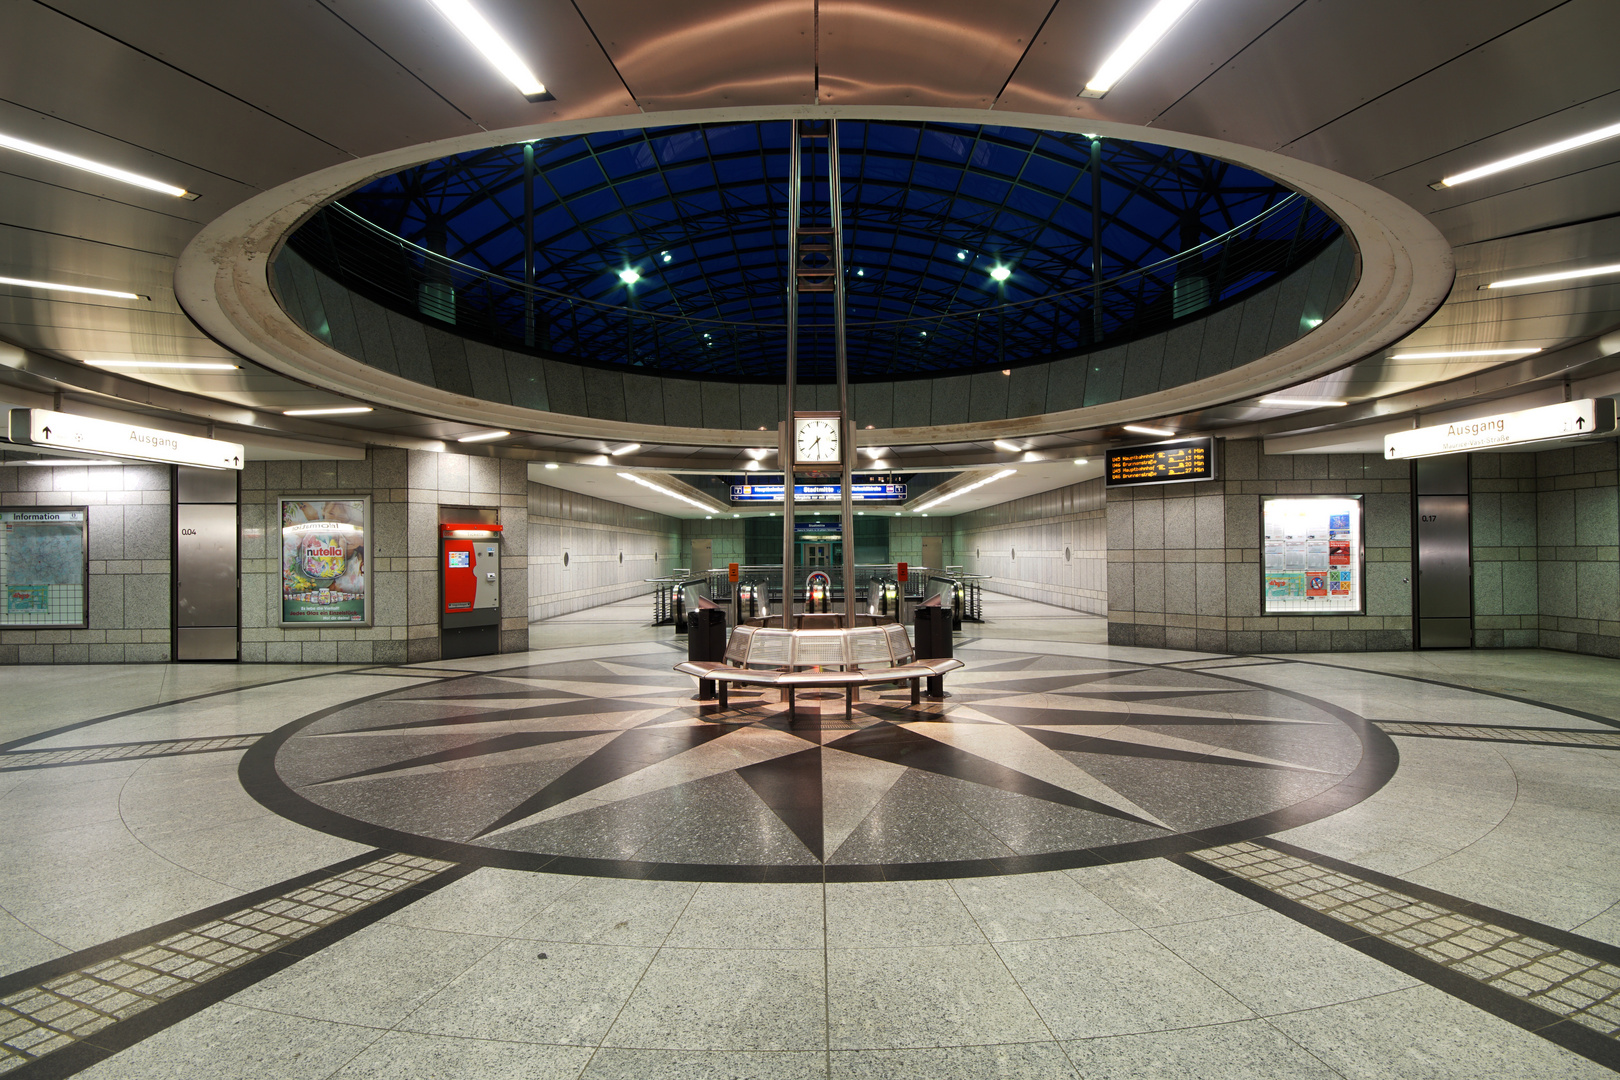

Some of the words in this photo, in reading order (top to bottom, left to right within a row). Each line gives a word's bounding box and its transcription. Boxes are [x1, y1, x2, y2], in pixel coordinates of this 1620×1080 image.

[1447, 419, 1505, 437] Ausgang
[129, 430, 178, 450] Ausgang
[1442, 434, 1510, 450] Maurice-Vast-Straße
[1122, 453, 1155, 461] Hauptbahnhof
[1122, 459, 1157, 467] Brunnenstraße
[1122, 465, 1155, 473] Hauptbahnhof
[1122, 471, 1157, 479] Brunnenstraße
[13, 512, 60, 521] Information
[1421, 515, 1437, 523] 0.17
[181, 528, 197, 536] 0.04
[306, 547, 342, 557] nutella
